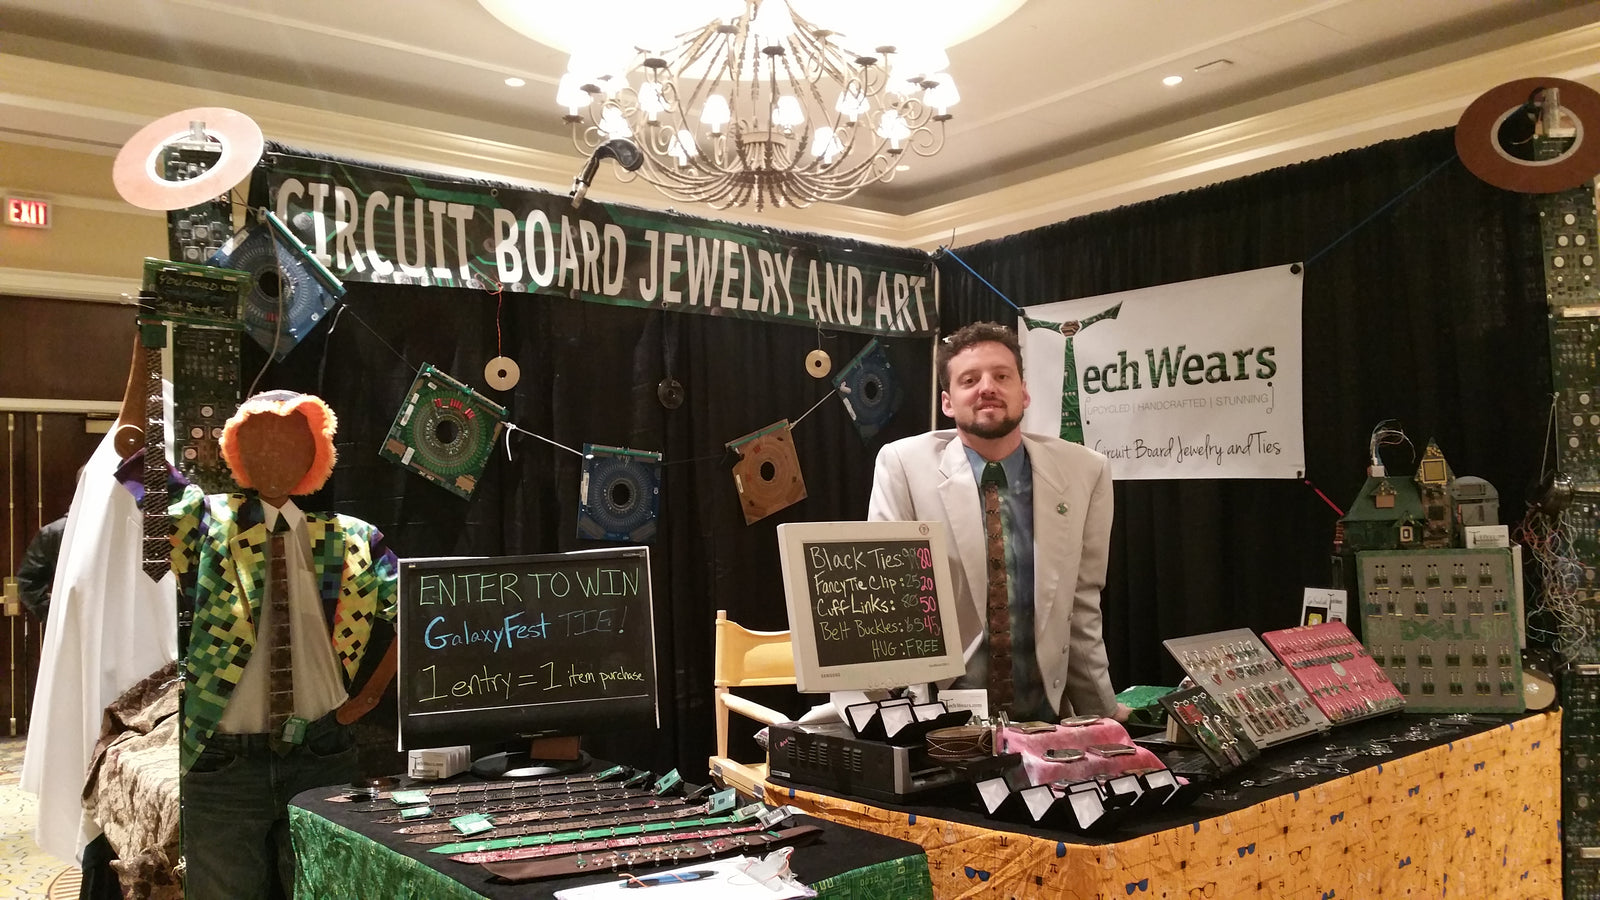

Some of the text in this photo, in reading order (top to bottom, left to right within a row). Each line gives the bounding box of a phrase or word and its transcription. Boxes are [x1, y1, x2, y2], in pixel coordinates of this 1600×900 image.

[8, 199, 47, 225] EXIT
[277, 178, 929, 332] CIRCUIT BOARD JEWELRY AND ART
[1087, 393, 1269, 416] UPCYCLED HANDCRAFTED STUNNING
[1095, 430, 1281, 465] Circuit Board Jewelry and Ties
[810, 546, 866, 571] Black
[916, 547, 932, 569] 80
[419, 567, 639, 606] ENTER TO WIN
[920, 575, 934, 591] 20
[920, 595, 937, 613] 50
[424, 610, 552, 653] GalaxyFest
[820, 620, 851, 641] Belt
[923, 614, 940, 637] 45
[905, 638, 938, 657] FREE
[418, 664, 448, 702] 1
[451, 665, 512, 700] entry
[539, 661, 562, 691] 1
[567, 663, 596, 687] item
[599, 666, 645, 690] purchase
